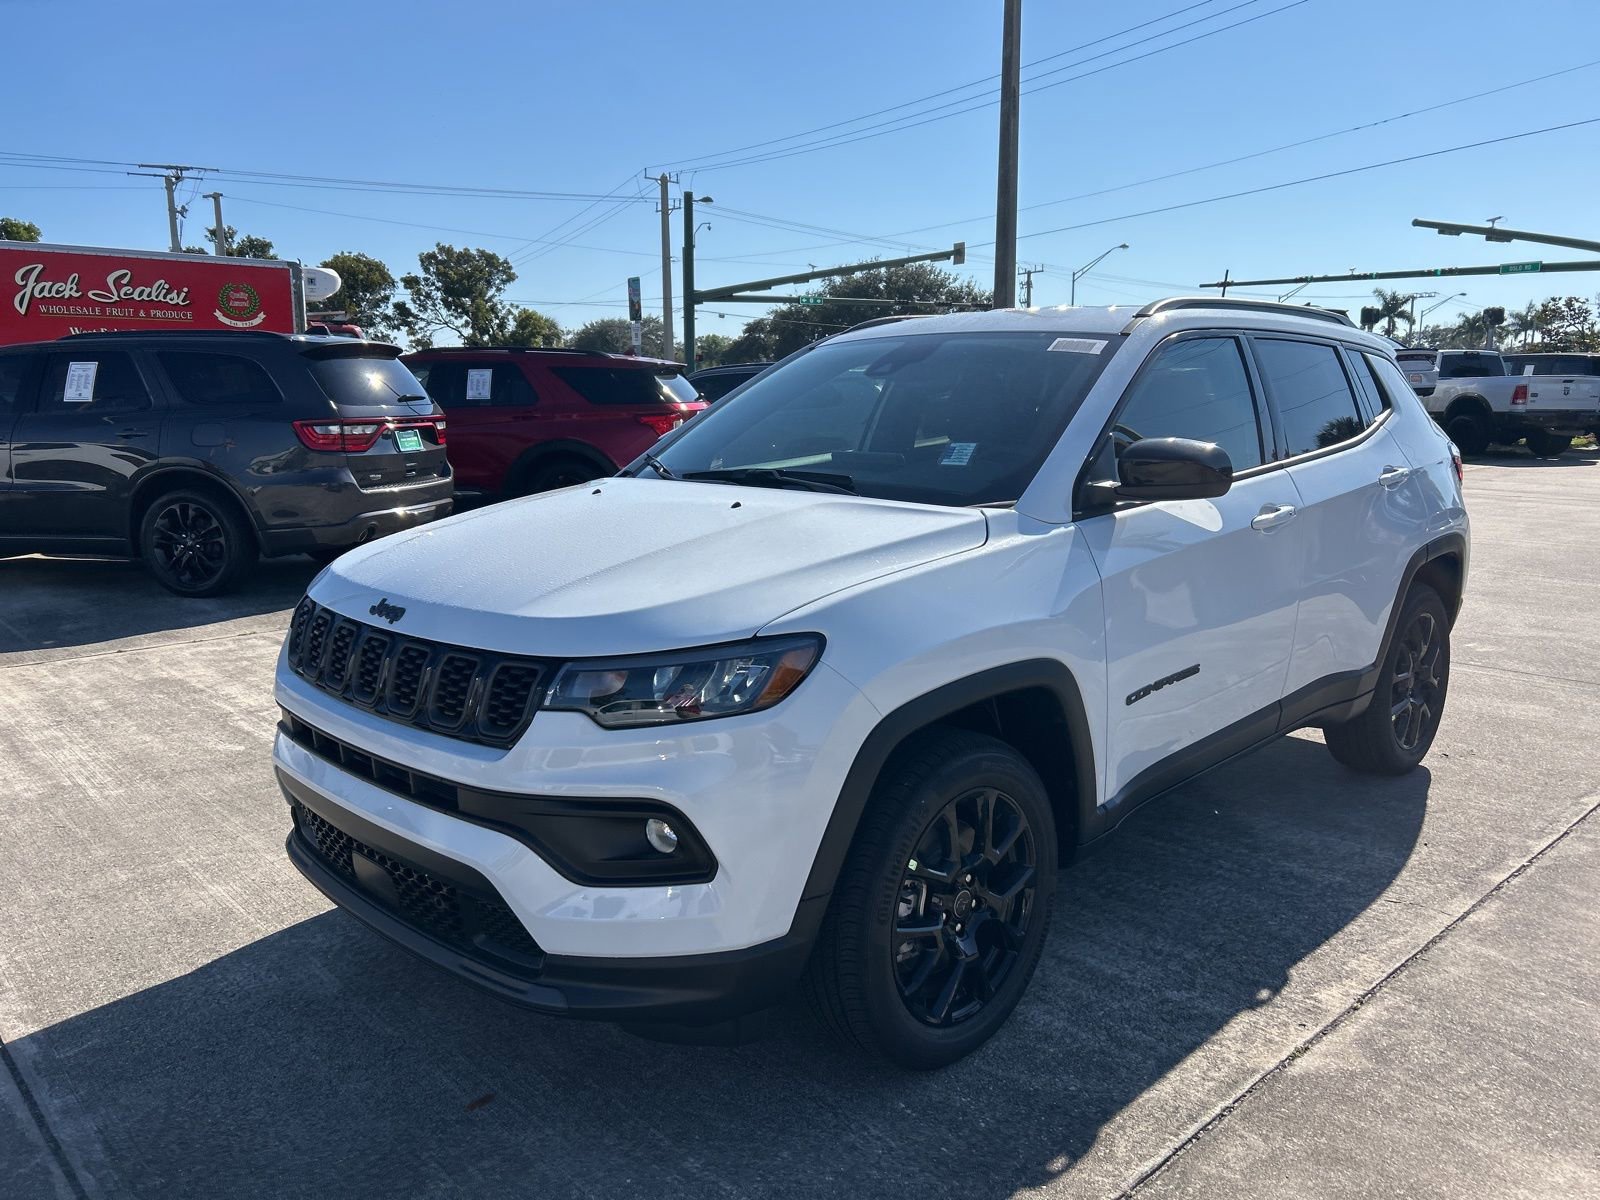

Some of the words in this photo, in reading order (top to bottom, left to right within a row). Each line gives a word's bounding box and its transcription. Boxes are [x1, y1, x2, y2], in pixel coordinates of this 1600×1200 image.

[13, 263, 82, 315] Jack
[87, 269, 190, 305] Scalisi
[39, 304, 101, 315] WHOLESALE
[106, 308, 135, 317] FRUIT
[150, 309, 193, 319] PRODUCE
[369, 597, 407, 625] Jeep
[1125, 663, 1200, 706] COMPASS
